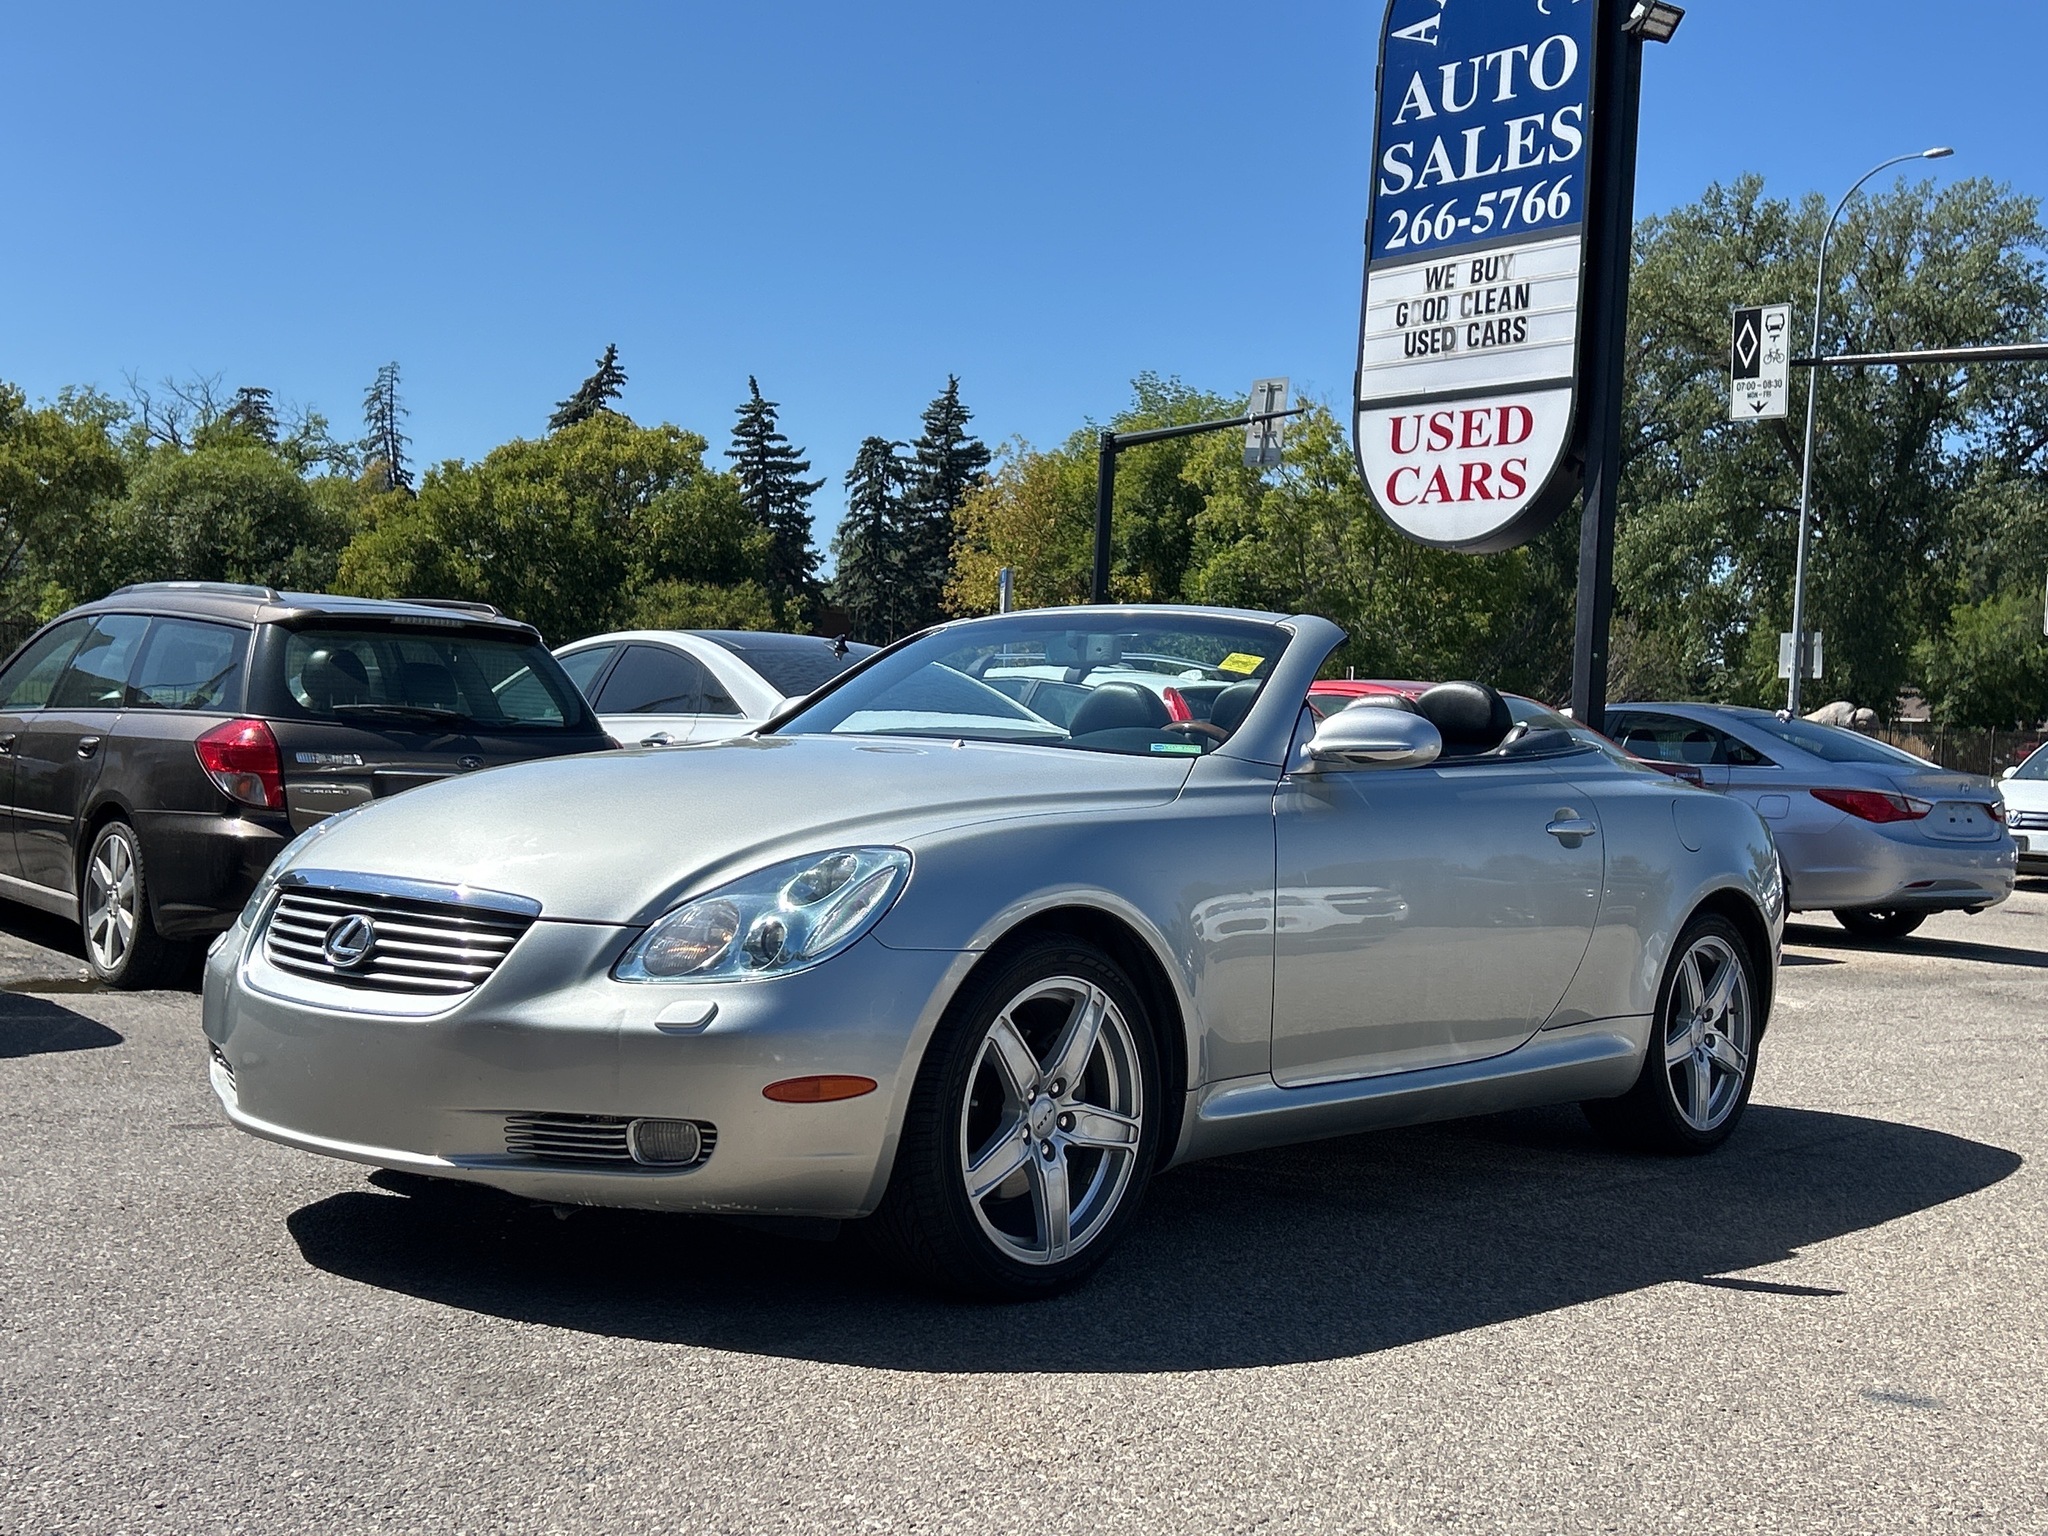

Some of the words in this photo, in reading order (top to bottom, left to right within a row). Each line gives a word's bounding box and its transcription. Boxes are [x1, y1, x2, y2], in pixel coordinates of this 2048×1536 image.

[1392, 34, 1578, 126] AUTO
[1380, 103, 1583, 197] SALES
[1385, 174, 1573, 250] 266-5766
[1425, 264, 1456, 292] WE
[1470, 254, 1515, 285] BUY
[1396, 295, 1449, 328] GOOD
[1460, 283, 1531, 318] CLEAN
[1404, 326, 1457, 357] USED
[1467, 316, 1528, 348] CARS
[1389, 405, 1534, 455] USED
[1385, 457, 1528, 507] CARS
